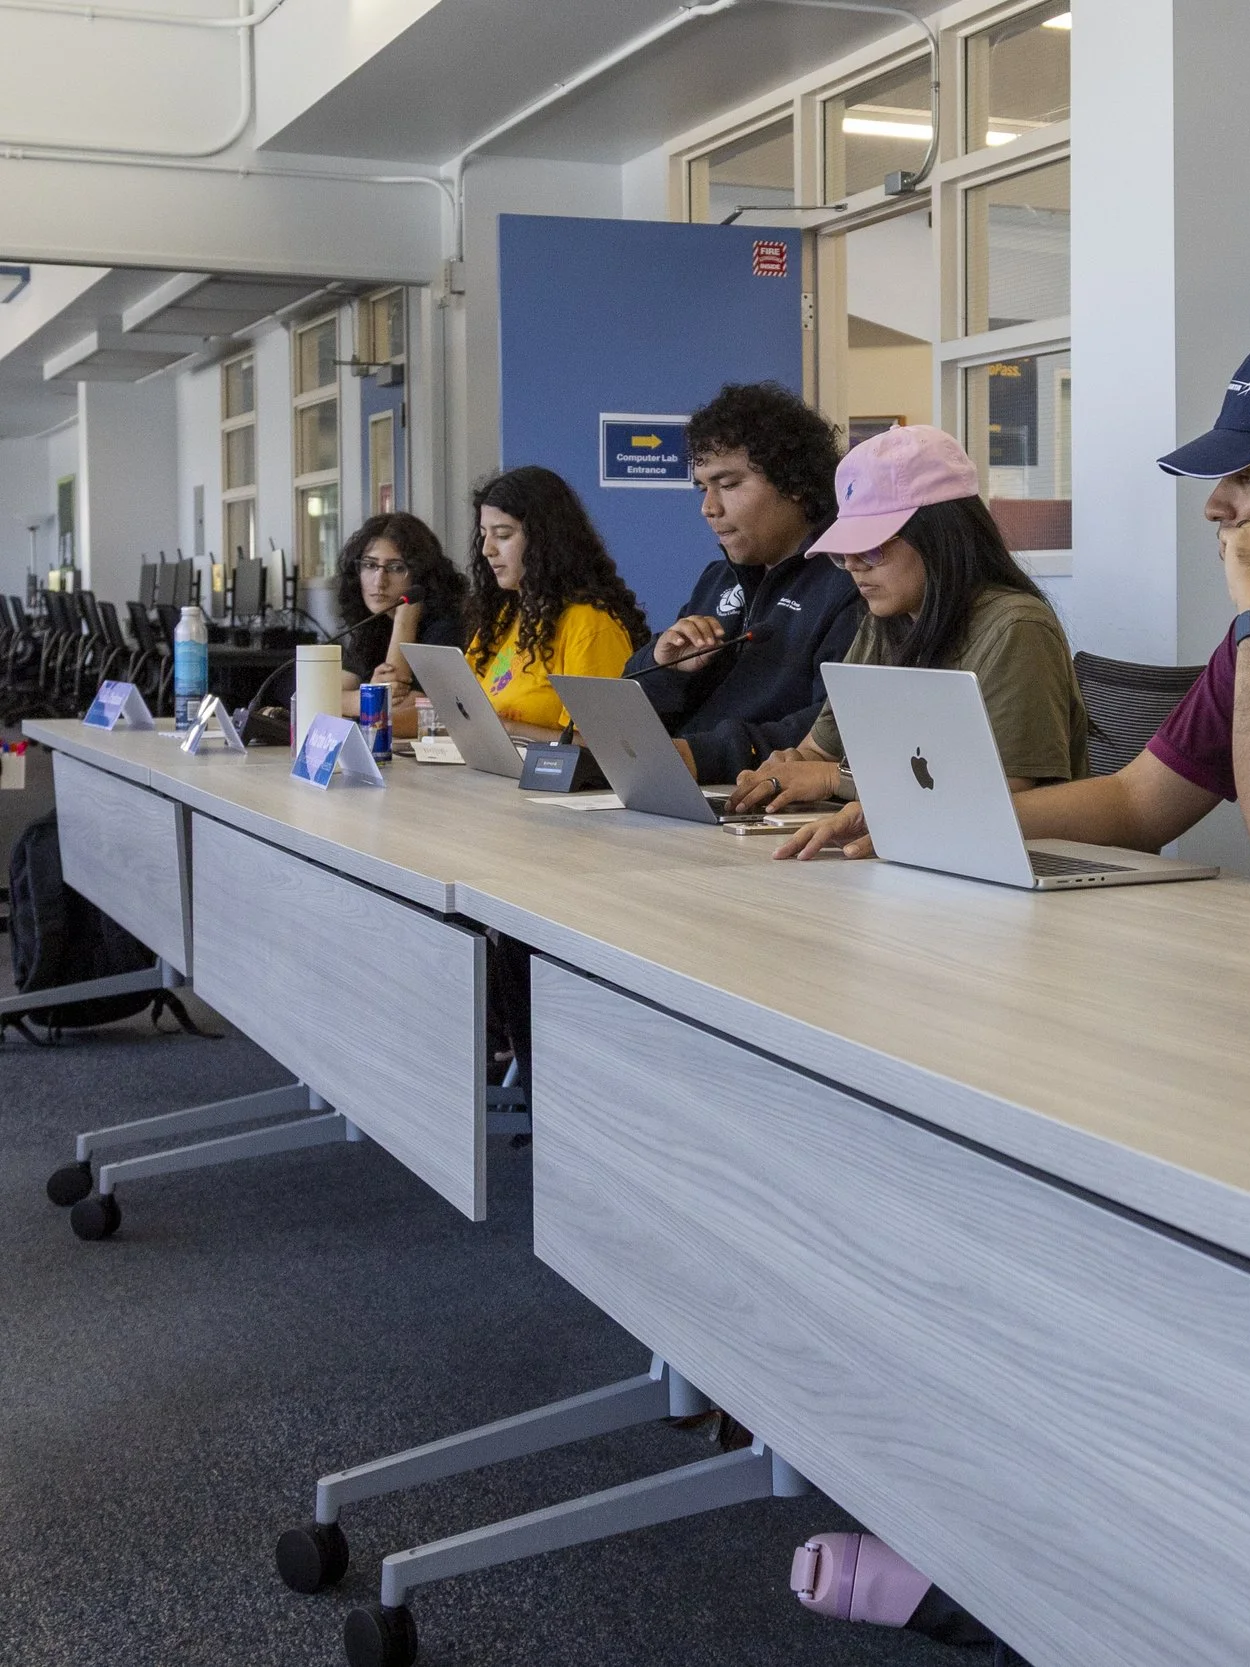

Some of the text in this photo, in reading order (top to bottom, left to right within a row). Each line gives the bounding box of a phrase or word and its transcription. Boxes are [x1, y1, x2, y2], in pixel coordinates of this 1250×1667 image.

[760, 247, 781, 256] FIRE
[616, 453, 678, 463] Computer Lab
[627, 466, 667, 474] Entrance
